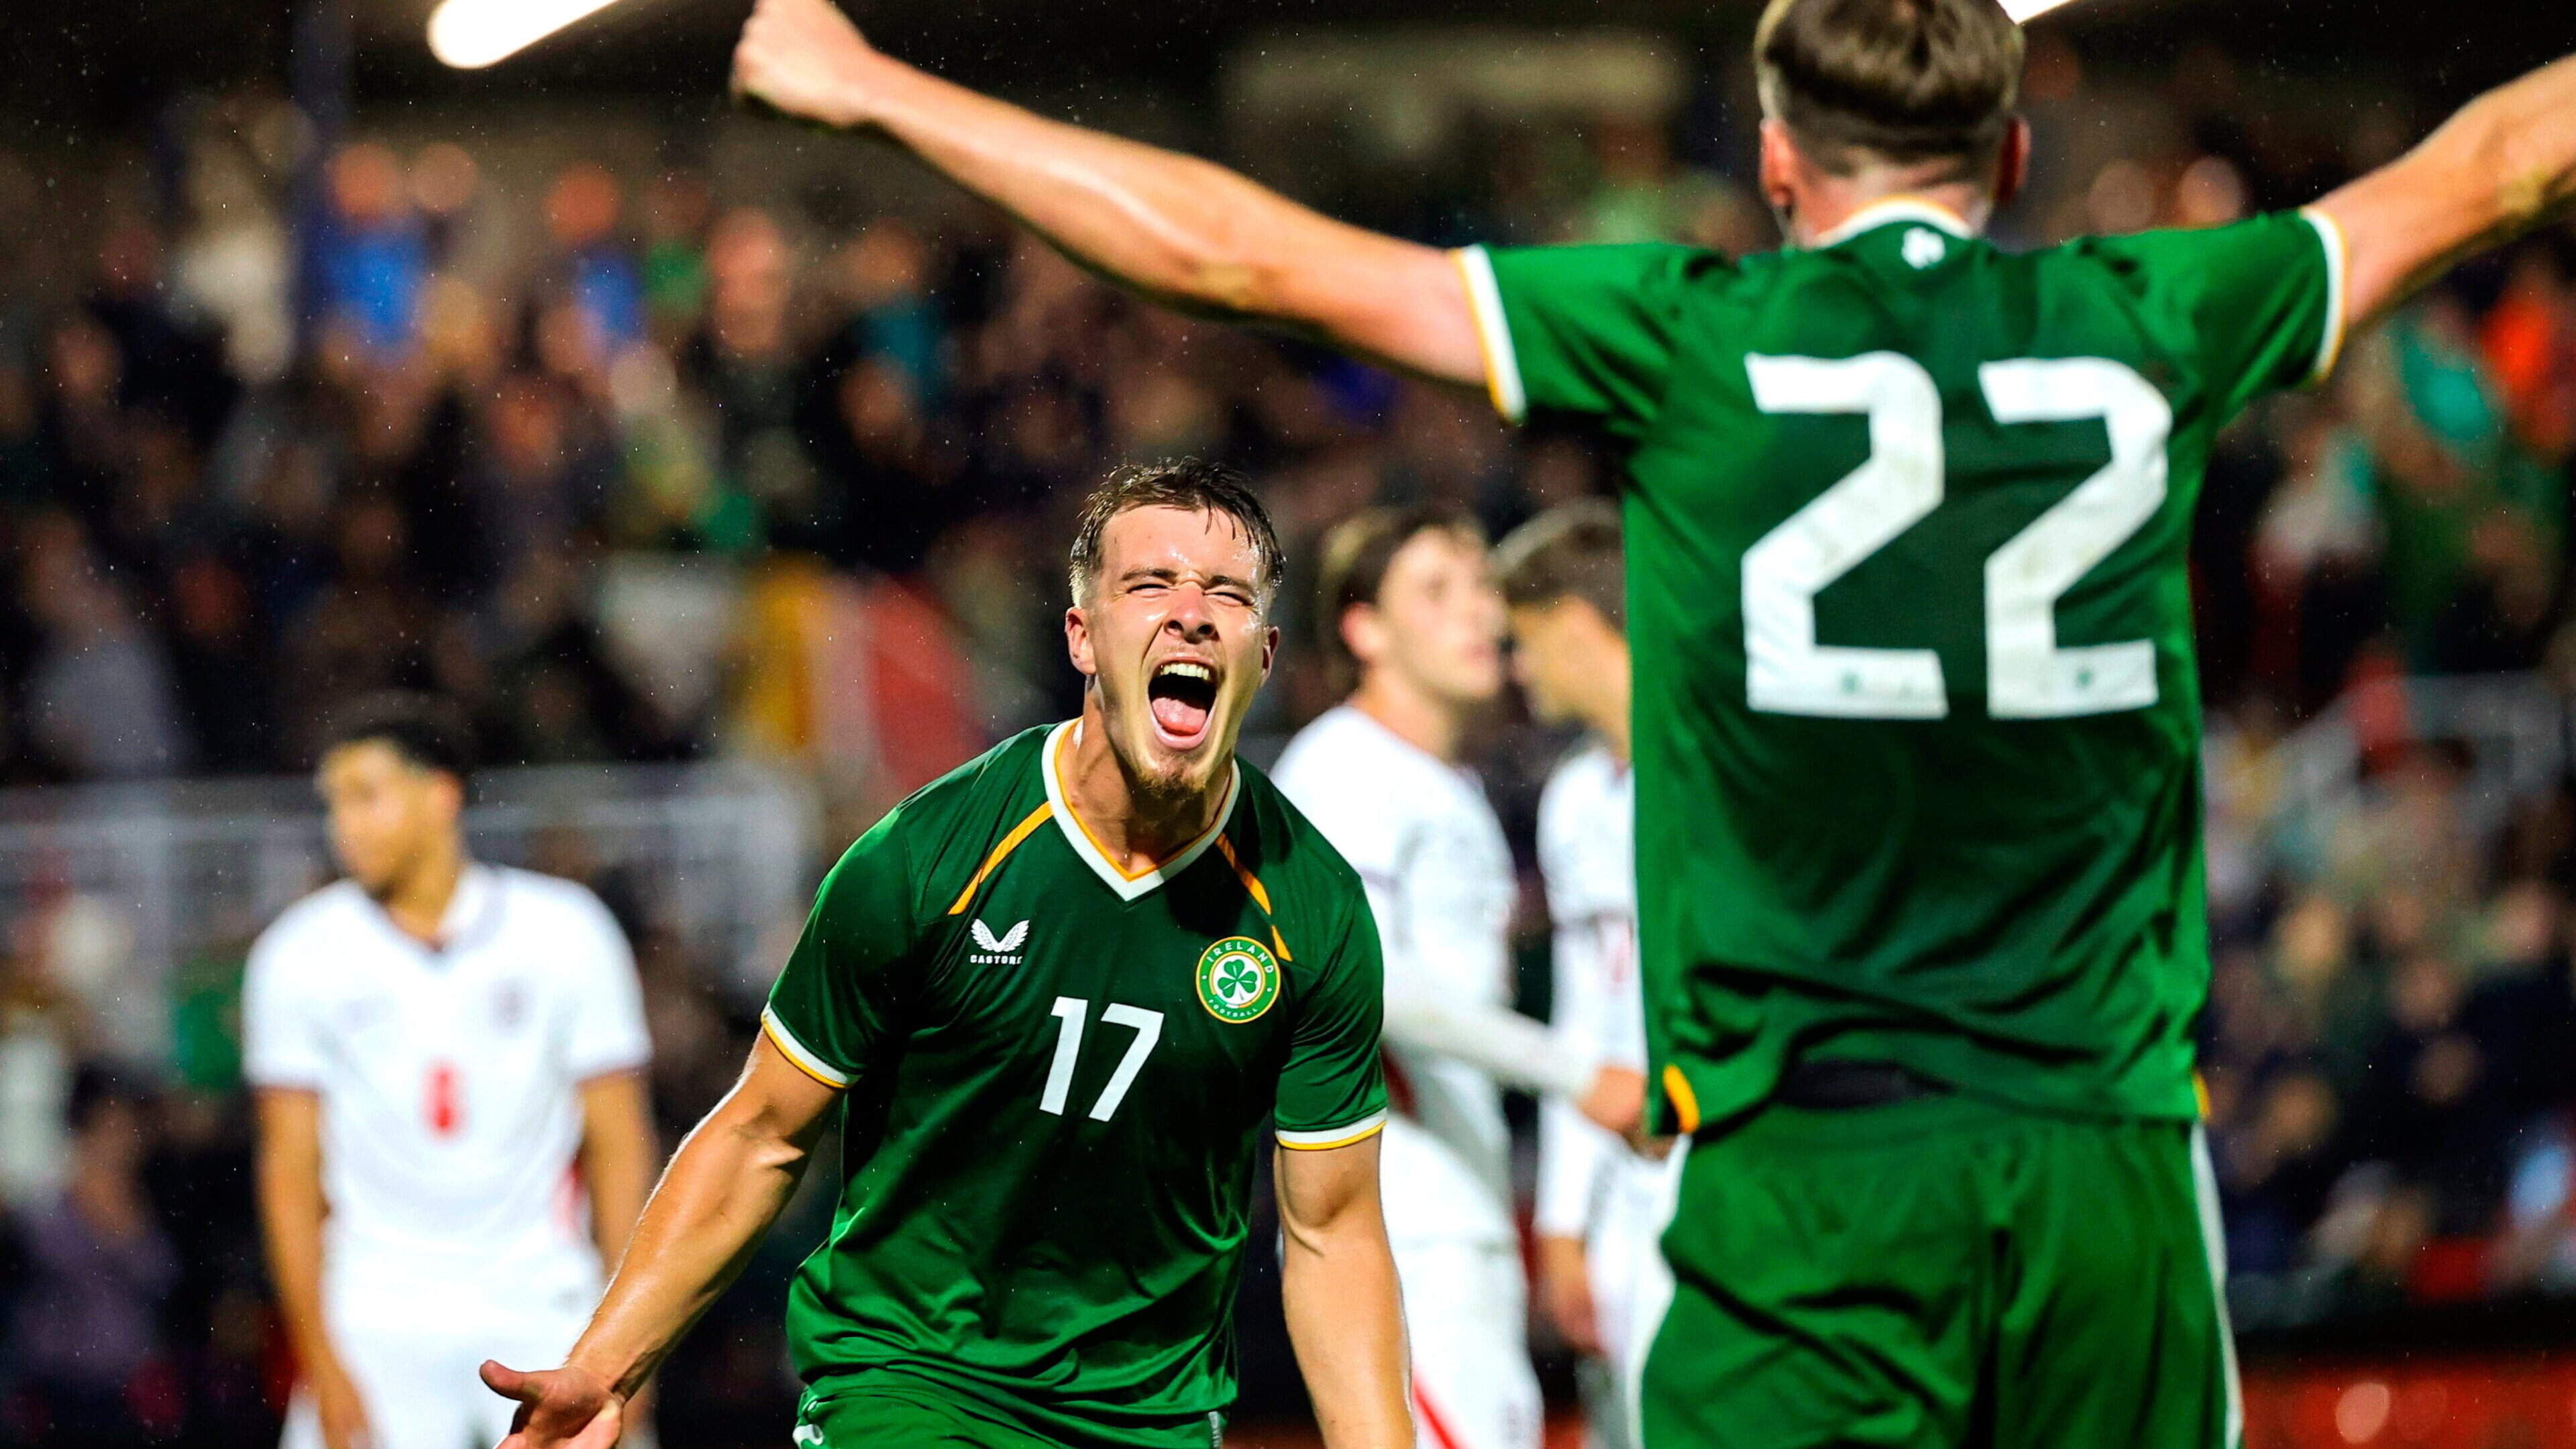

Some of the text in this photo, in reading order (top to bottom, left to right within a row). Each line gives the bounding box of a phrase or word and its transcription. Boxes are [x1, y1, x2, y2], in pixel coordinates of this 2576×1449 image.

[1741, 350, 2173, 719] 22
[1206, 941, 1274, 973] IRELAND
[1039, 996, 1165, 1122] 17
